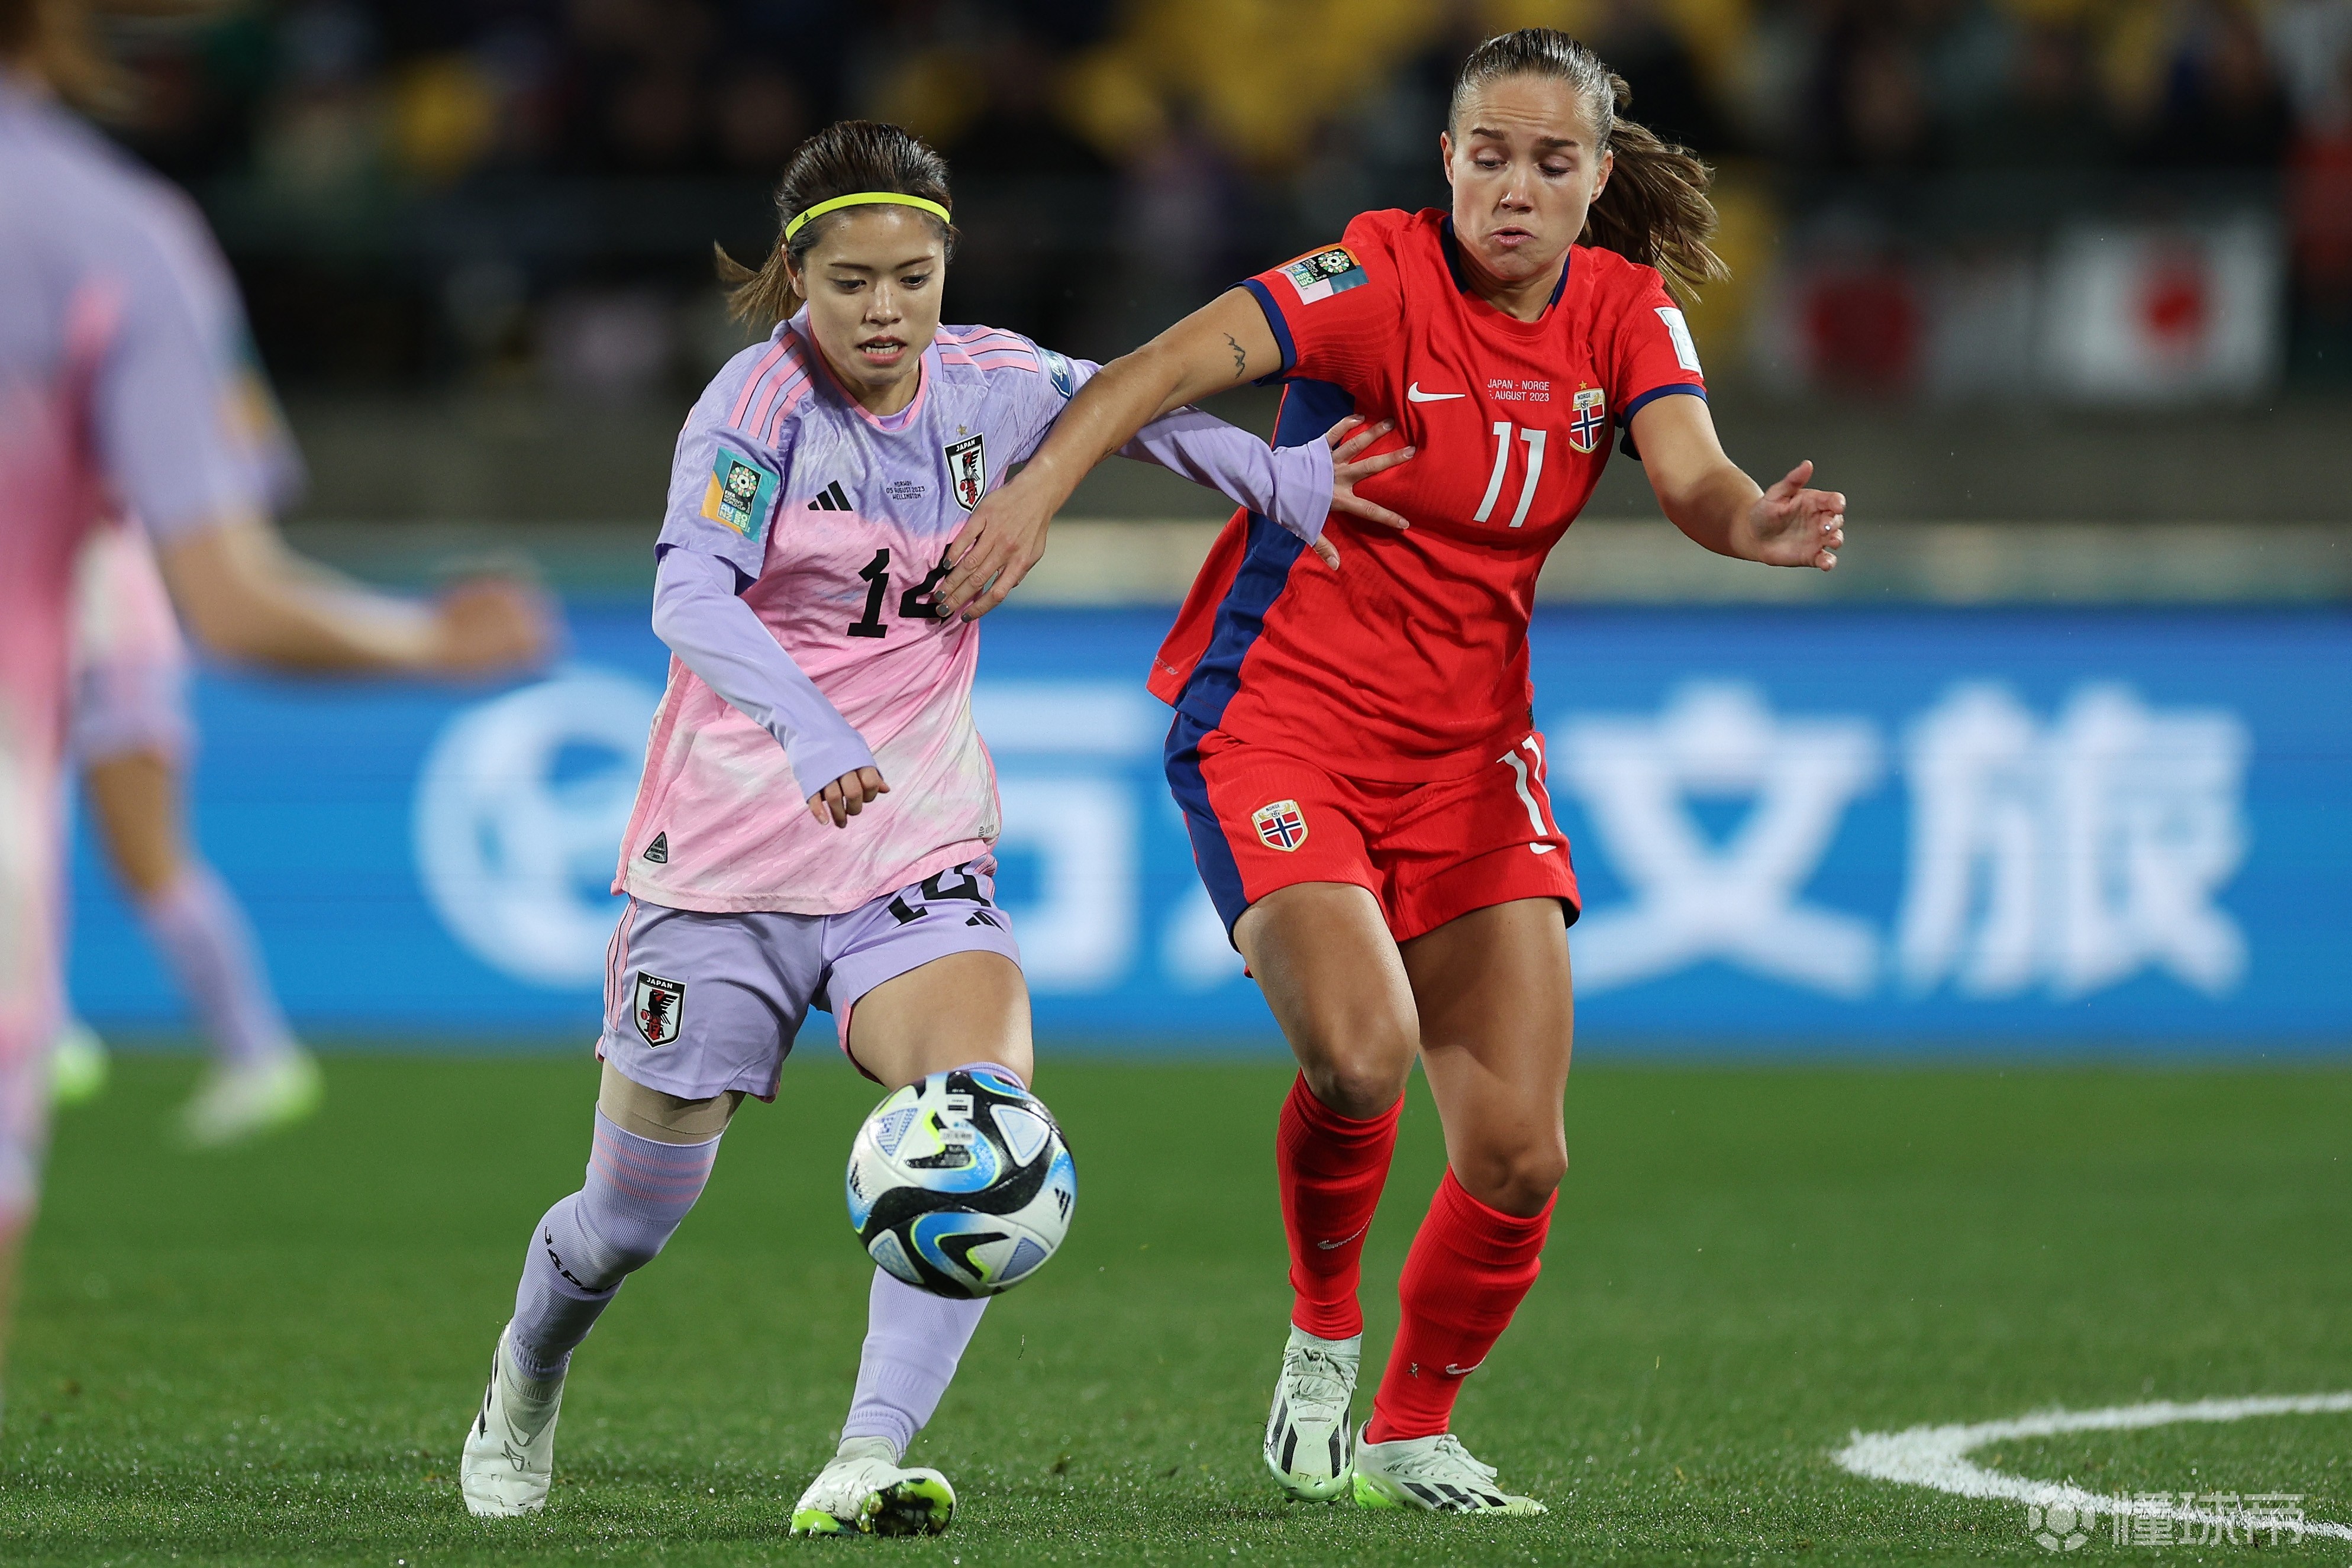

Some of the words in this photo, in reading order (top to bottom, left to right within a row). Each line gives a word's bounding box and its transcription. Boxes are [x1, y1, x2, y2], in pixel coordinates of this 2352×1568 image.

[1487, 378, 1513, 389] JAPAN
[1522, 380, 1550, 391] NORGE
[1494, 391, 1527, 401] AUGUST
[1530, 393, 1550, 402] 2023
[1577, 392, 1591, 401] NORGE
[956, 439, 976, 452] JAPAN
[1473, 421, 1547, 527] 11
[1496, 735, 1561, 836] 11
[1266, 804, 1280, 812] NORGE
[646, 977, 673, 989] JAPAN
